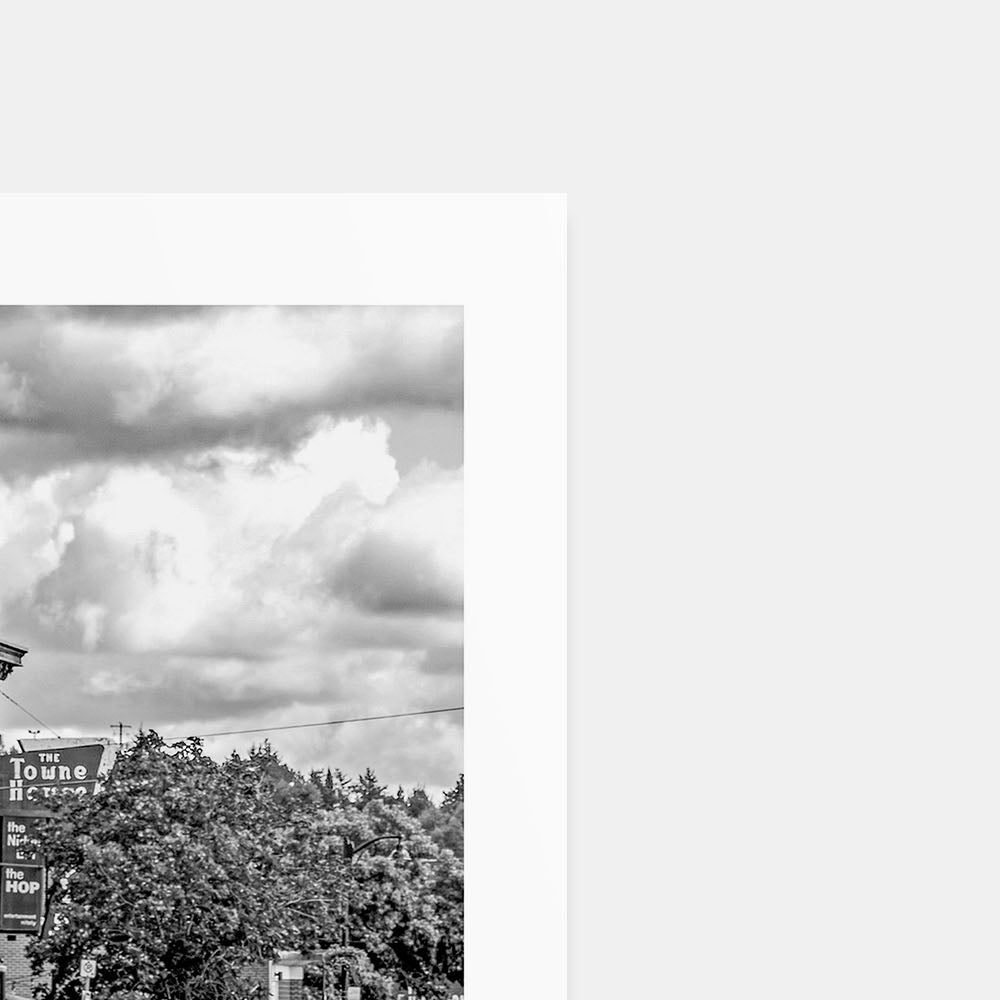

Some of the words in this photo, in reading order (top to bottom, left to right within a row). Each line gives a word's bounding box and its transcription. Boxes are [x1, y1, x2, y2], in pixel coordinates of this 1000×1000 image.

[38, 753, 60, 763] THE
[9, 757, 88, 780] Towne
[7, 821, 26, 833] the
[5, 868, 25, 880] the
[5, 880, 41, 895] HOP
